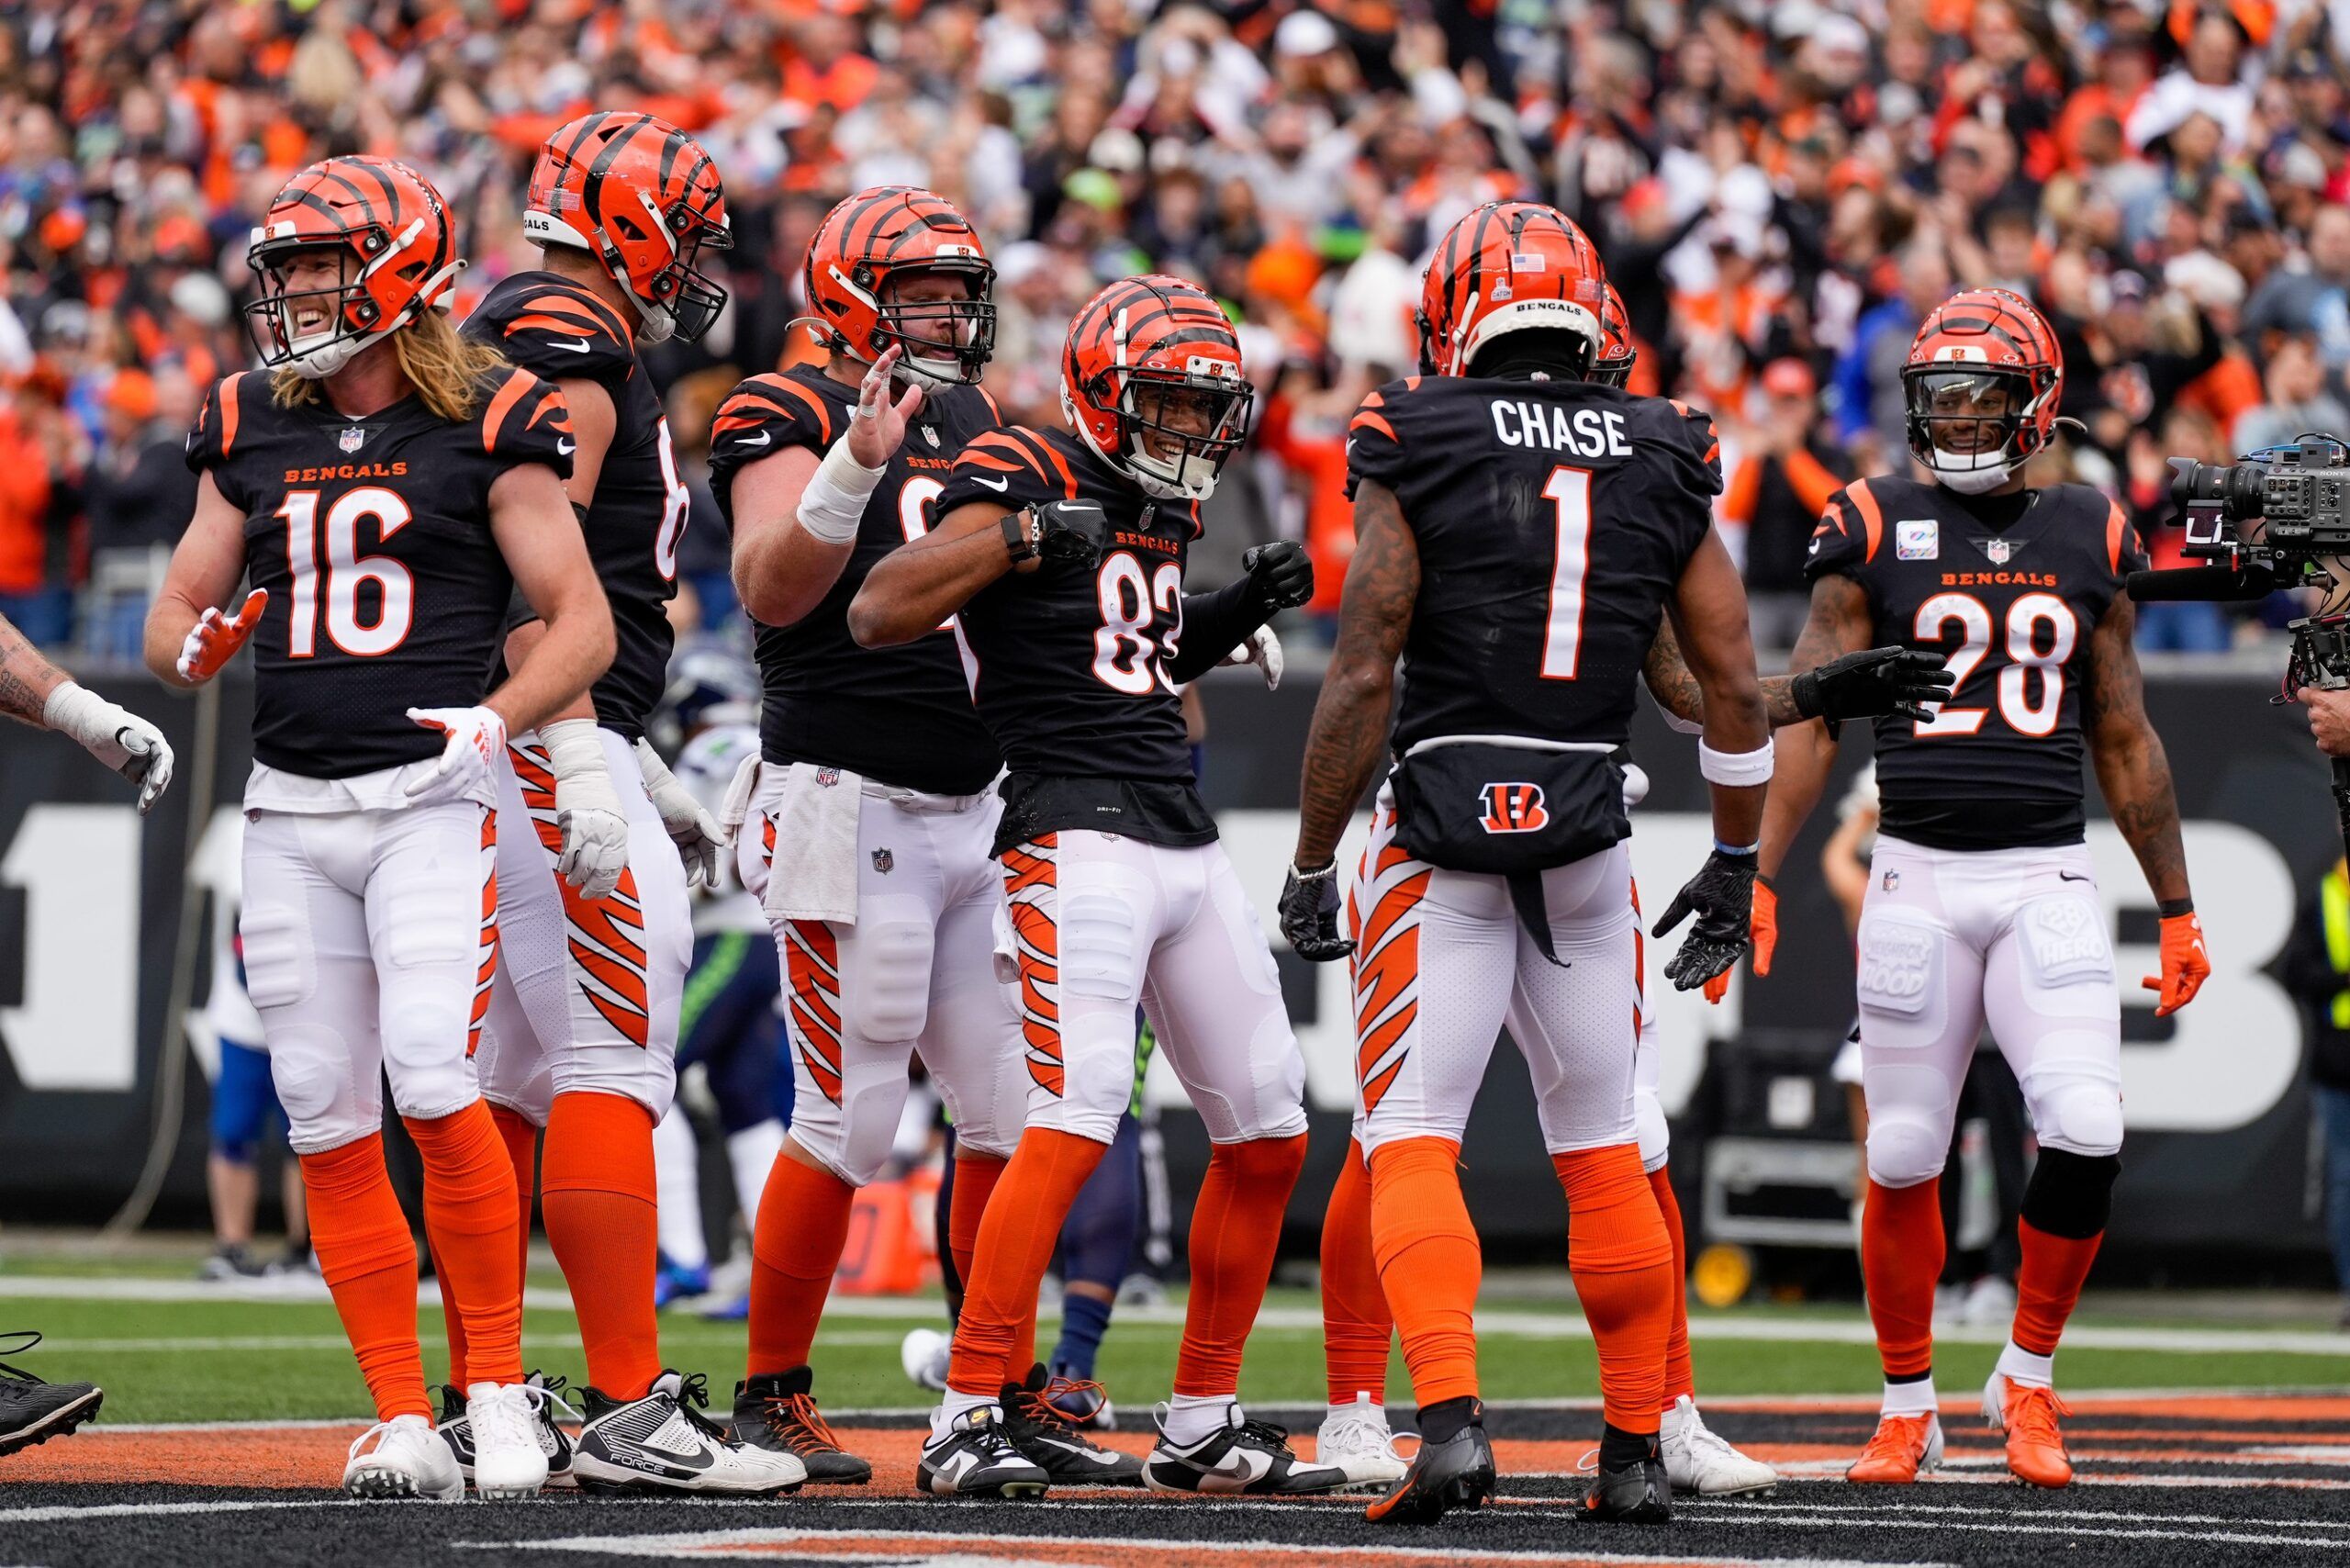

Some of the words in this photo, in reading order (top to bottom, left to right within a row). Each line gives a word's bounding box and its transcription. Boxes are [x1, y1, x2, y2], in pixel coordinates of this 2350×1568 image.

[1516, 302, 1582, 316] BENGALS
[1491, 399, 1634, 458] CHASE
[283, 462, 408, 483] BENGALS
[1114, 532, 1180, 555] BENGALS
[273, 485, 416, 659] 16
[1539, 464, 1594, 680] 1
[1941, 572, 2058, 588] BENGALS
[1091, 550, 1183, 697] 83
[1912, 590, 2079, 739] 28
[1096, 806, 1122, 814] DRI-FIT
[2040, 935, 2106, 968] HERO
[610, 1452, 666, 1475] FORCE
